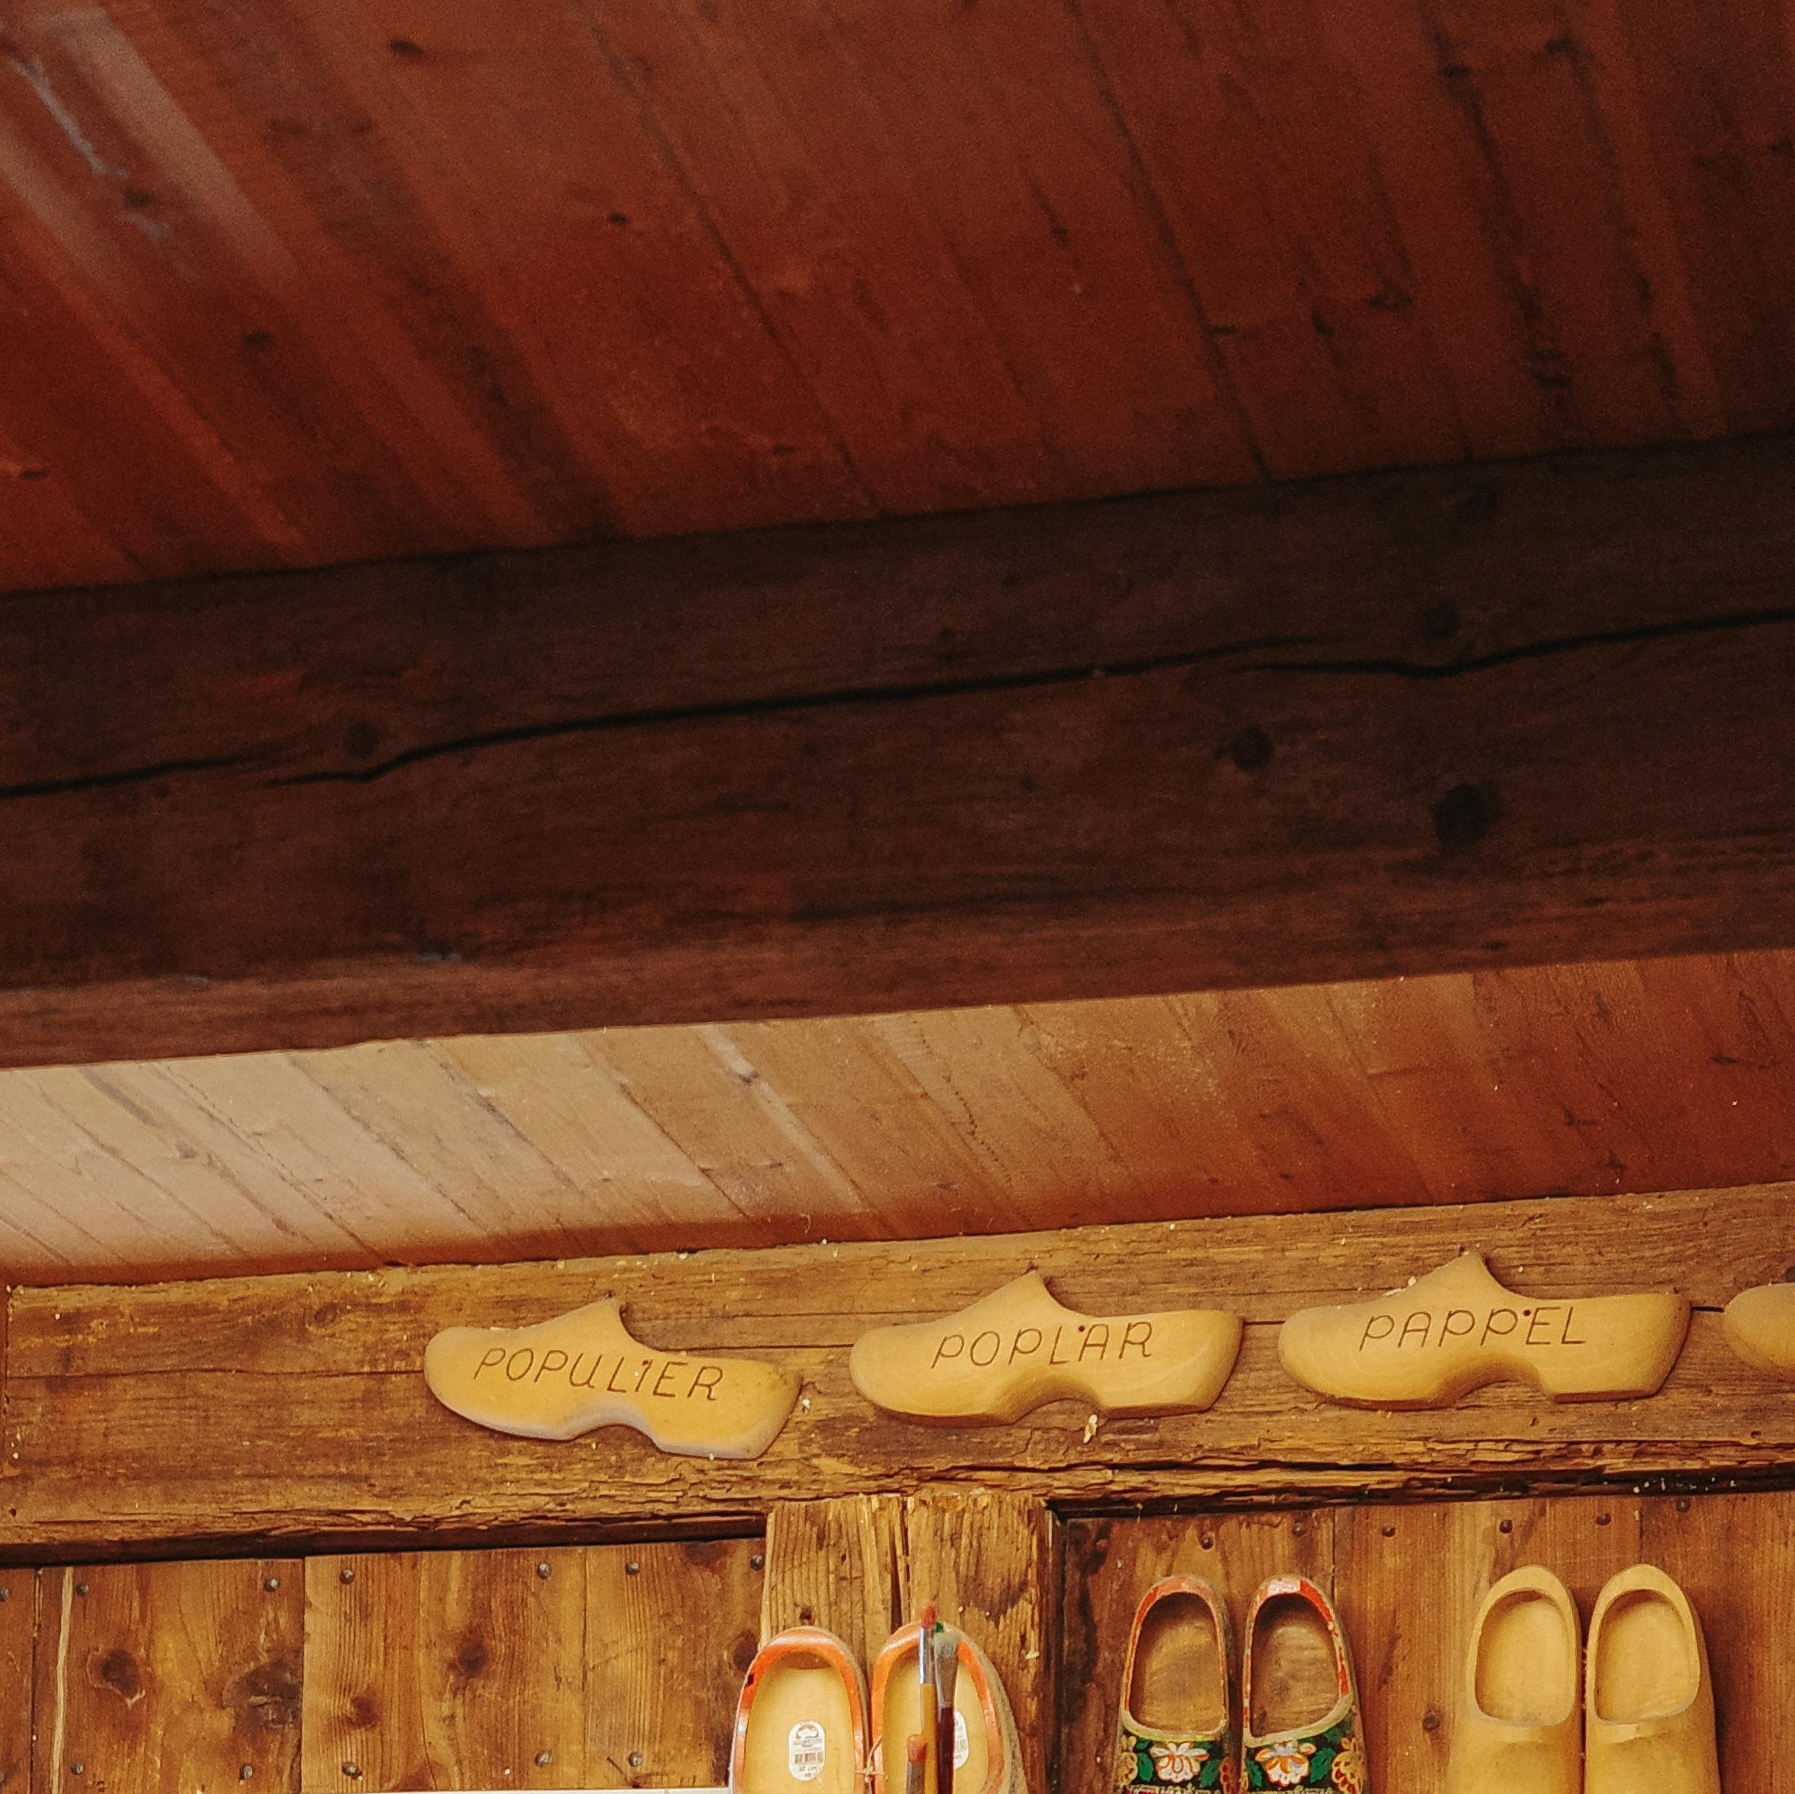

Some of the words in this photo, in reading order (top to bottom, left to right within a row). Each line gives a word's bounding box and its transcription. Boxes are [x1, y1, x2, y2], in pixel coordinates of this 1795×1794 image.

[930, 1320, 1153, 1369] POPLAR
[1358, 1305, 1588, 1351] PAPPEL
[474, 1347, 724, 1401] POPULIER
